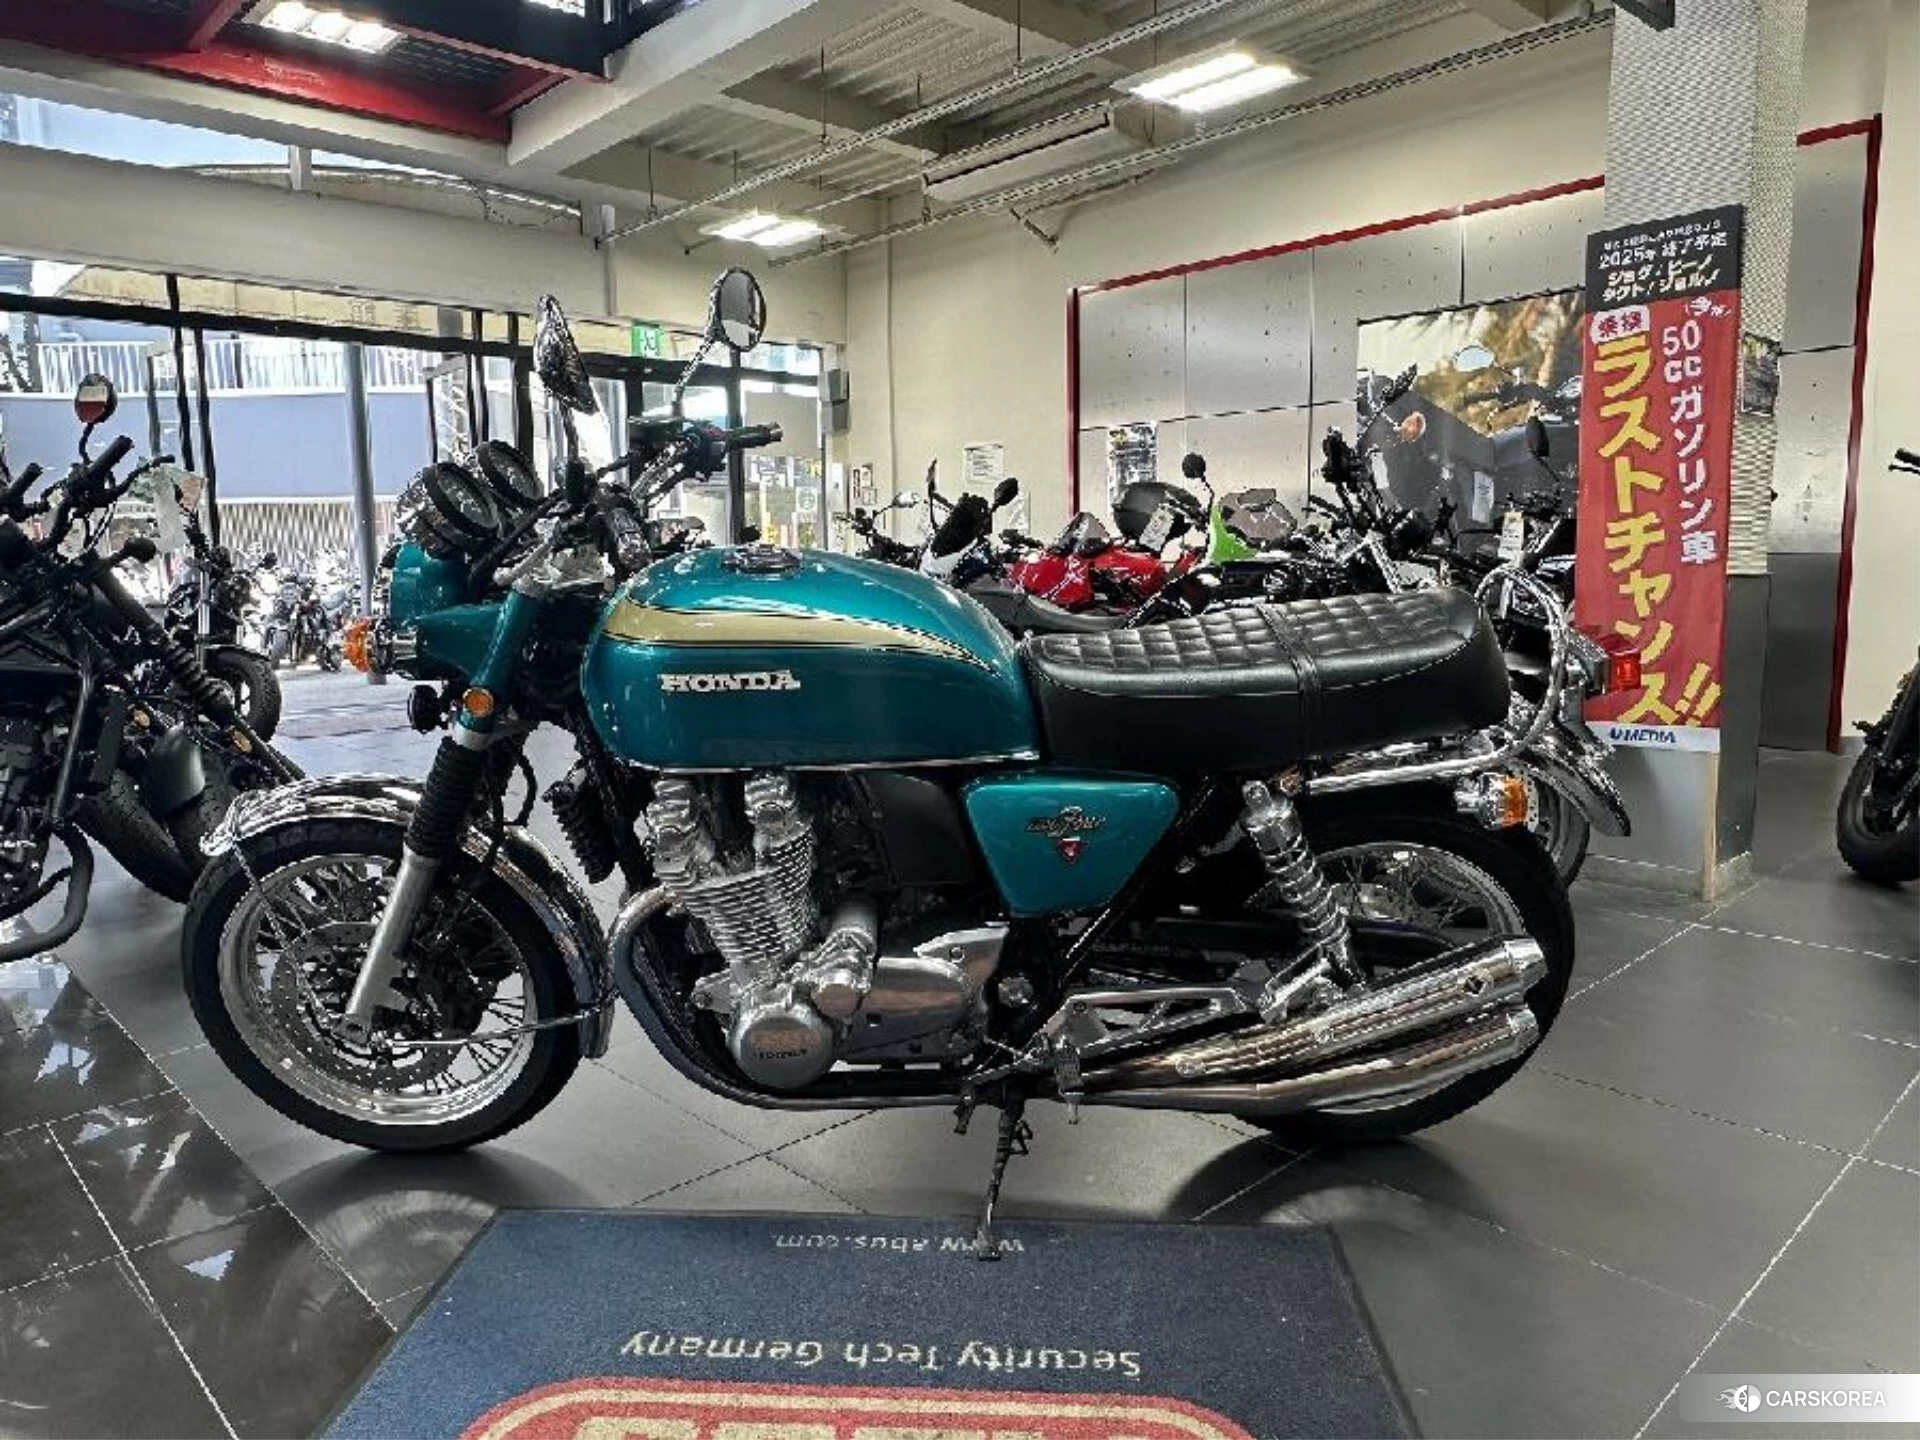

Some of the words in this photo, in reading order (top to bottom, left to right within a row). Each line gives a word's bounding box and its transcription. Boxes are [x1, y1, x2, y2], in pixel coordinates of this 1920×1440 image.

[657, 669, 801, 692] HONDA
[620, 1330, 824, 1367] Germany
[844, 1342, 944, 1371] Tech
[957, 1341, 1141, 1381] Security
